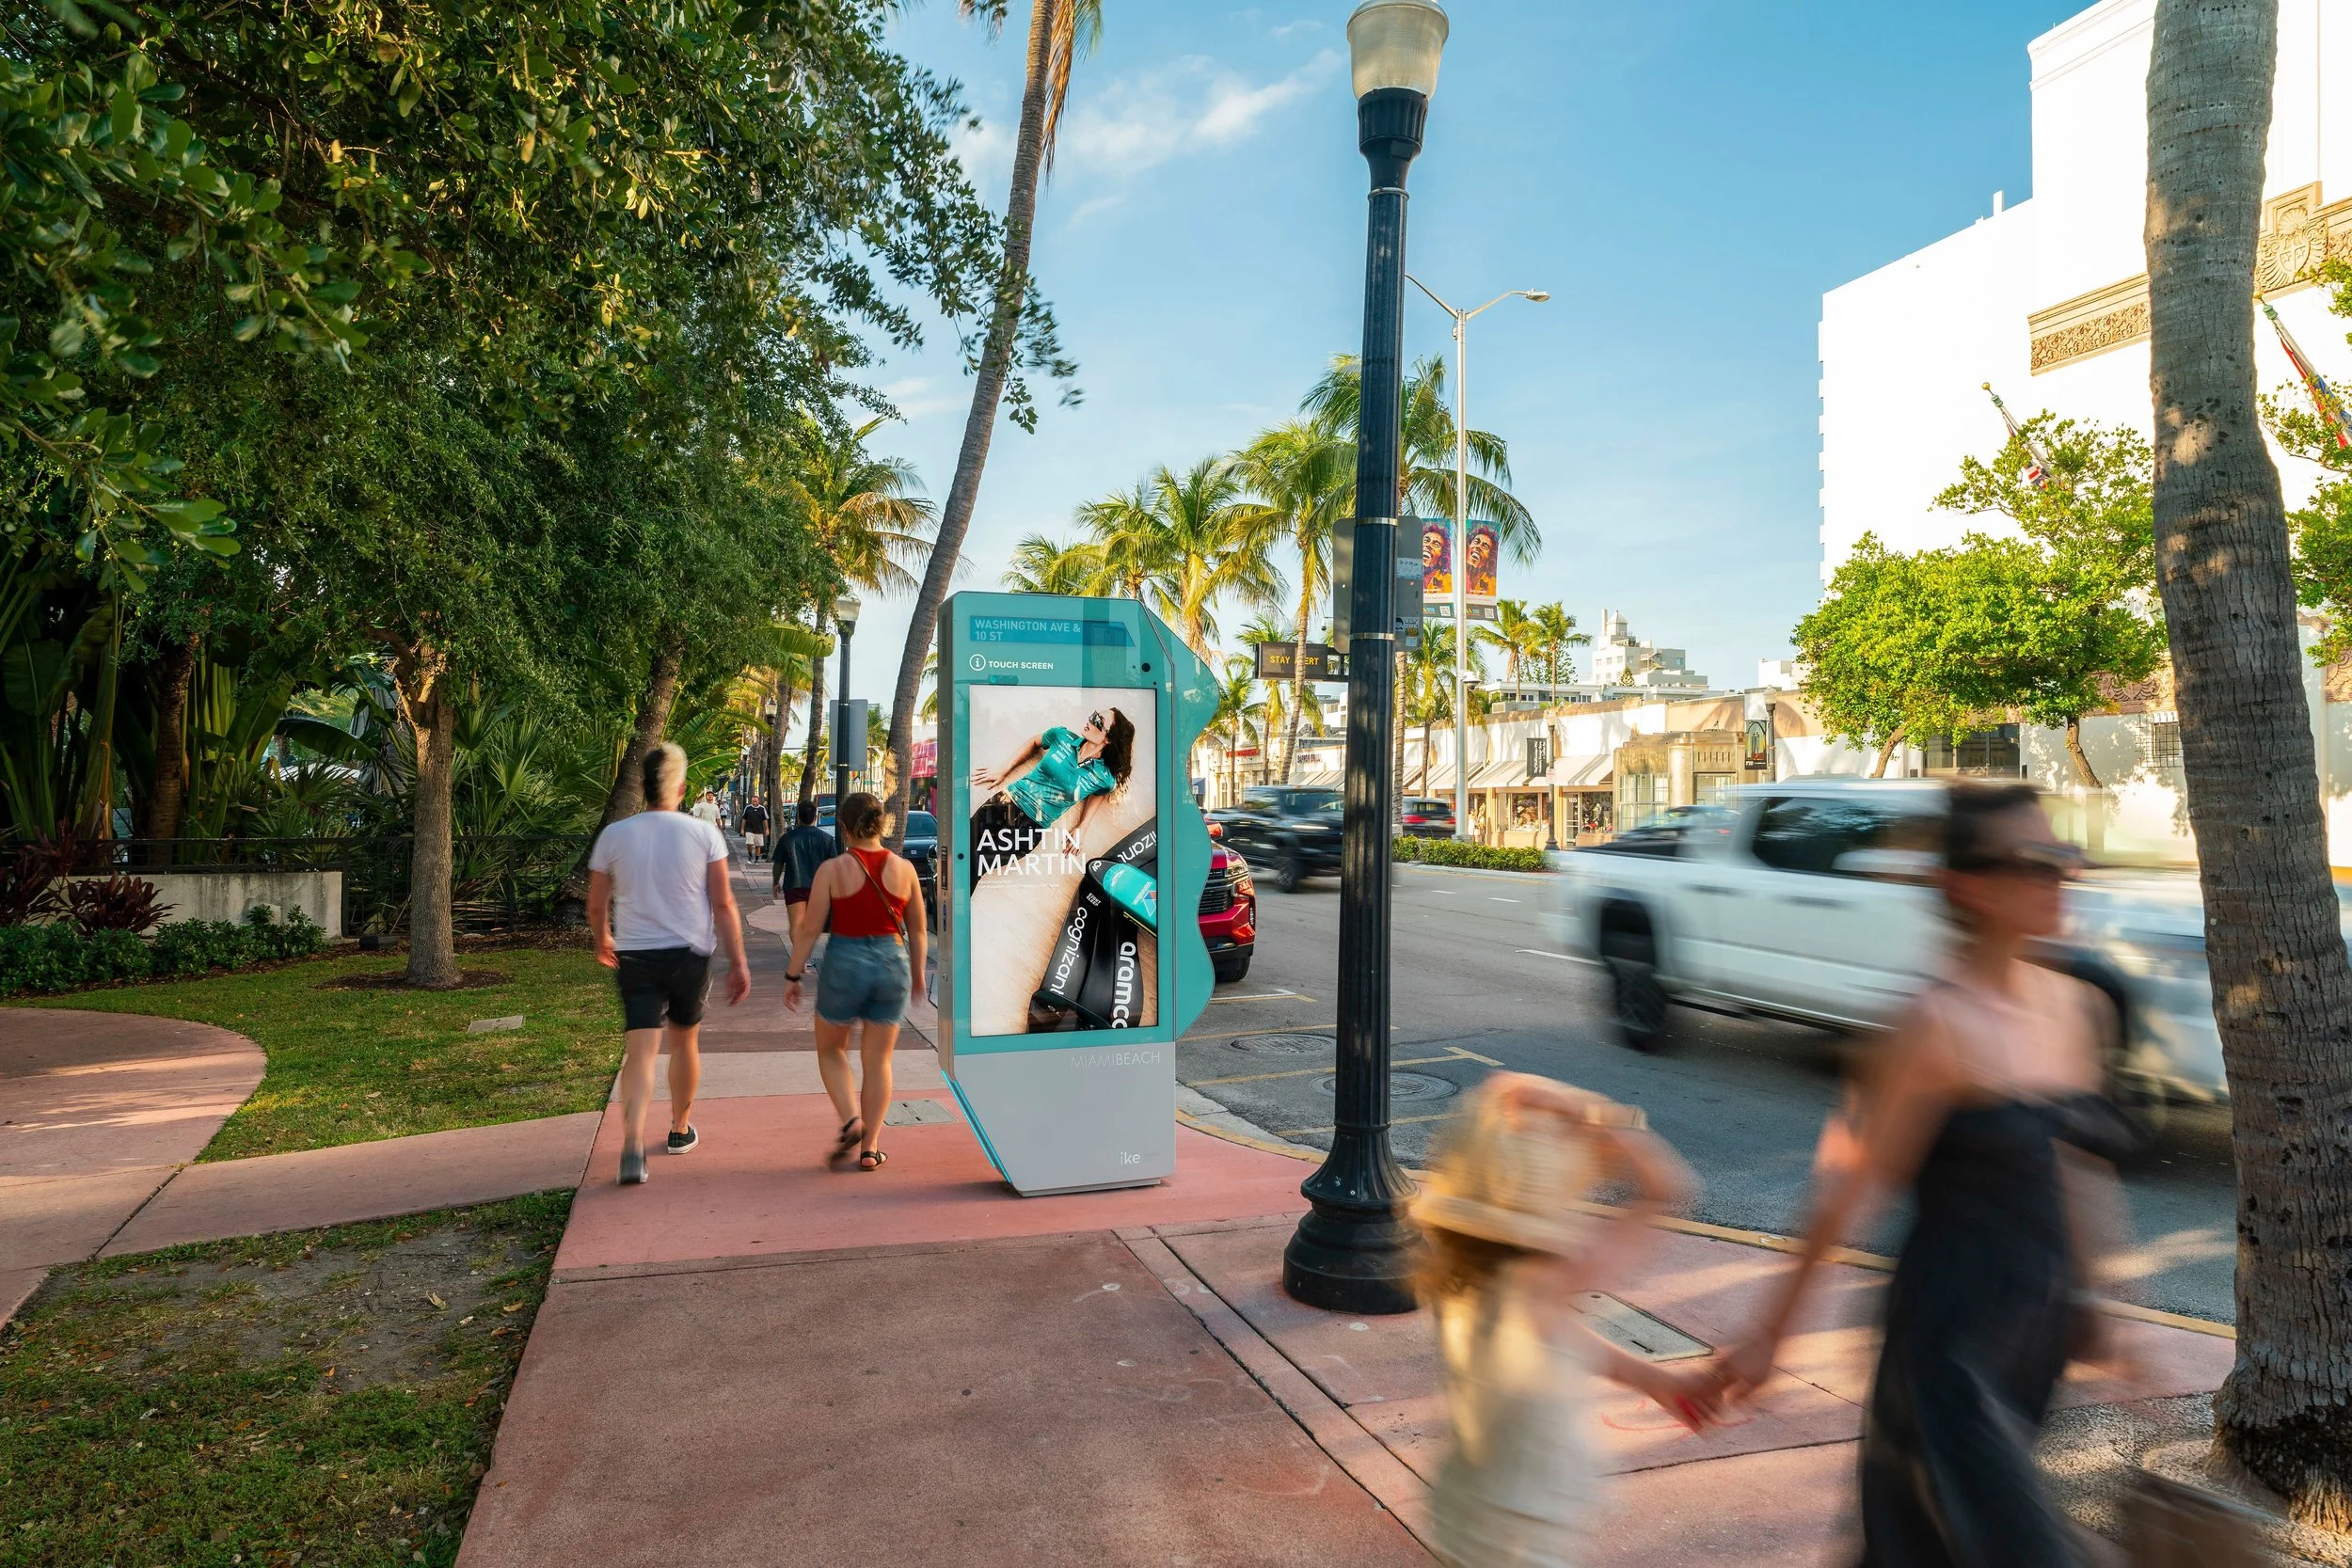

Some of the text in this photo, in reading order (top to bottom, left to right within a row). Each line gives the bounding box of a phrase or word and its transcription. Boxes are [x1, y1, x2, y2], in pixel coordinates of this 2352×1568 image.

[975, 619, 1081, 633] WASHINGTON AVE &
[975, 631, 1003, 641] 10 ST
[988, 660, 1054, 670] TOUCH SCREEN
[1269, 656, 1290, 664] STAY
[977, 828, 1080, 851] ASHTIN
[977, 853, 1087, 877] MARTIN
[1049, 907, 1088, 996] cognizant
[1120, 1151, 1140, 1165] ike
